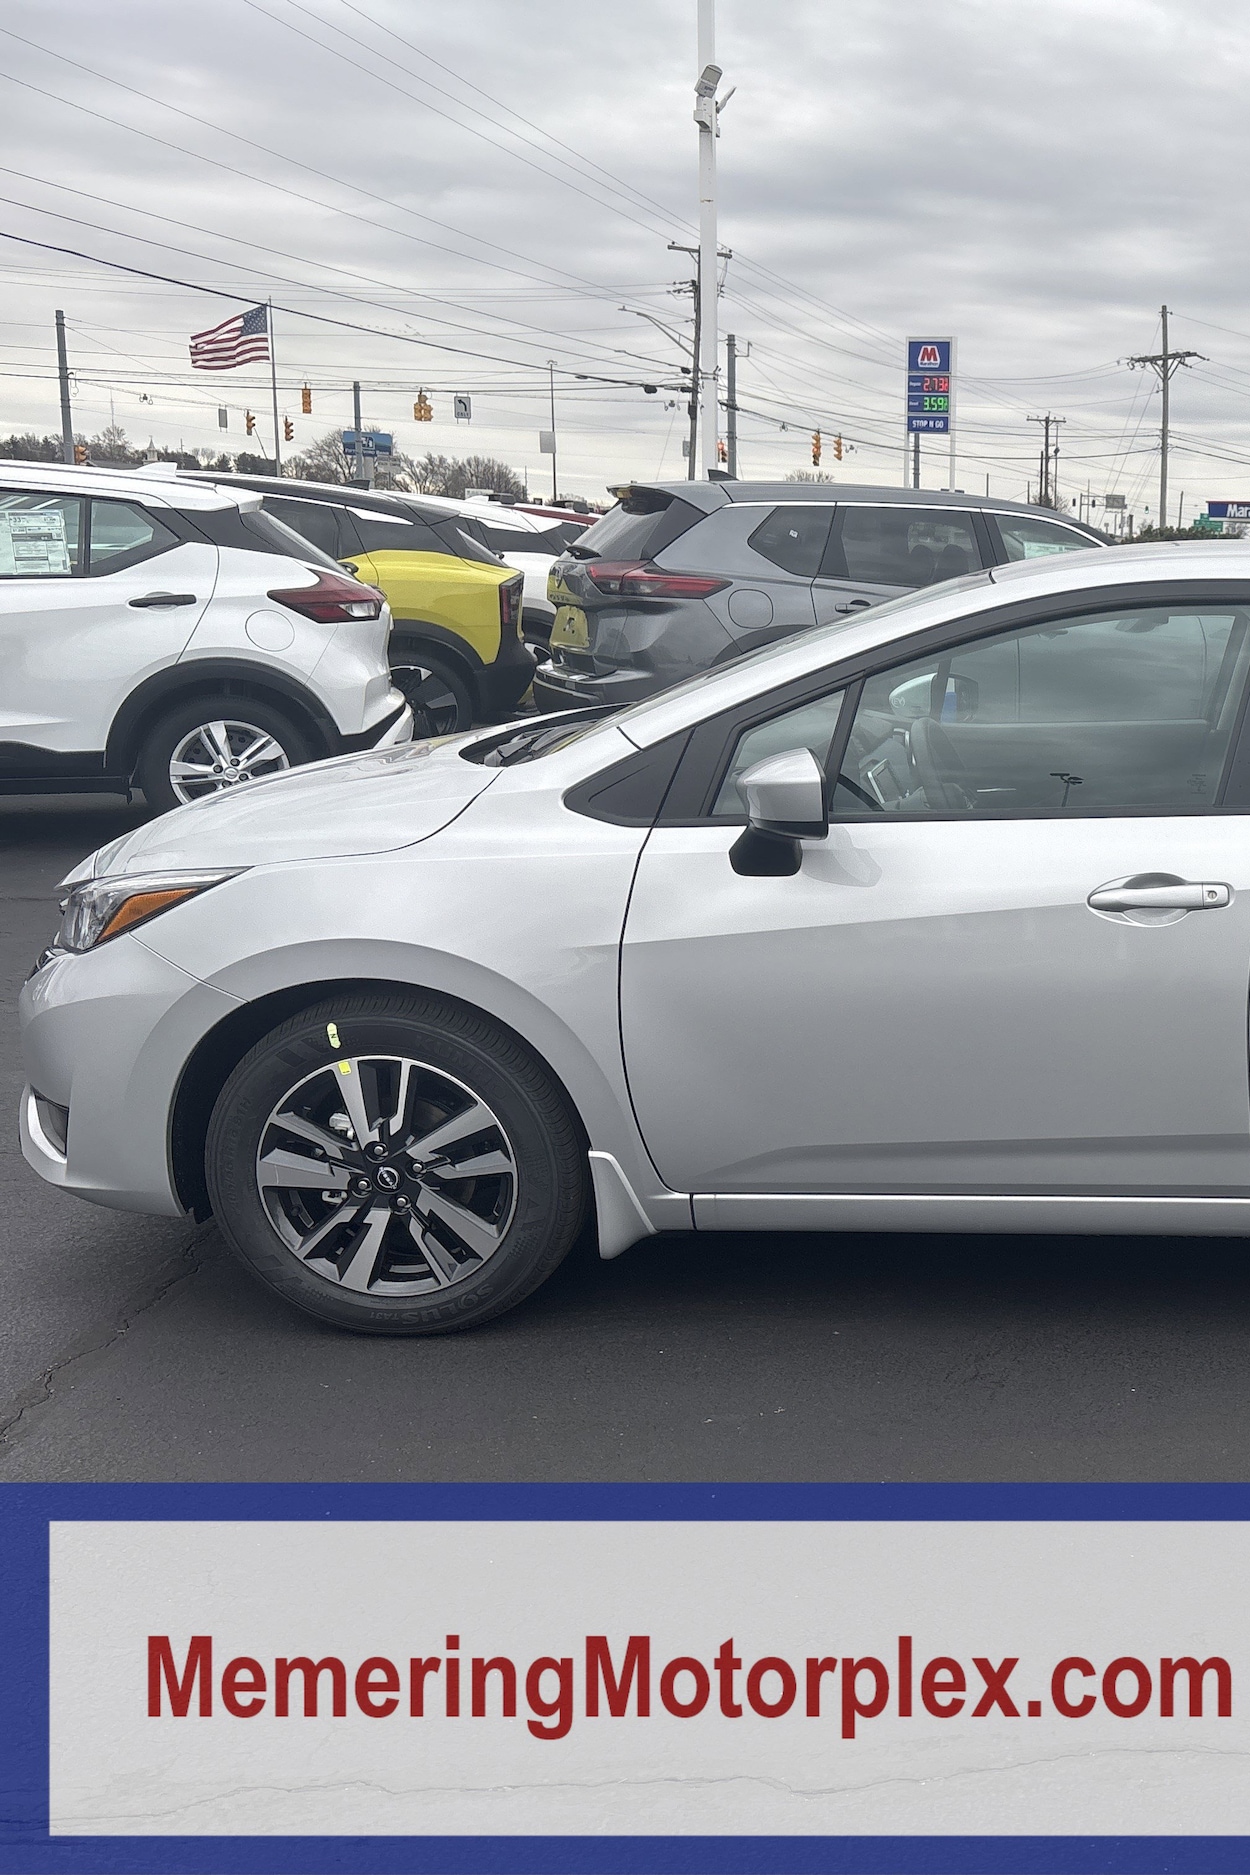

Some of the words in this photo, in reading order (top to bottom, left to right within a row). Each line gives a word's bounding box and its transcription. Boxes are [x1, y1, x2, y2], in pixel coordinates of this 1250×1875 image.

[912, 420, 928, 428] STOP
[935, 420, 944, 428] GO
[401, 1283, 494, 1325] SOLUS
